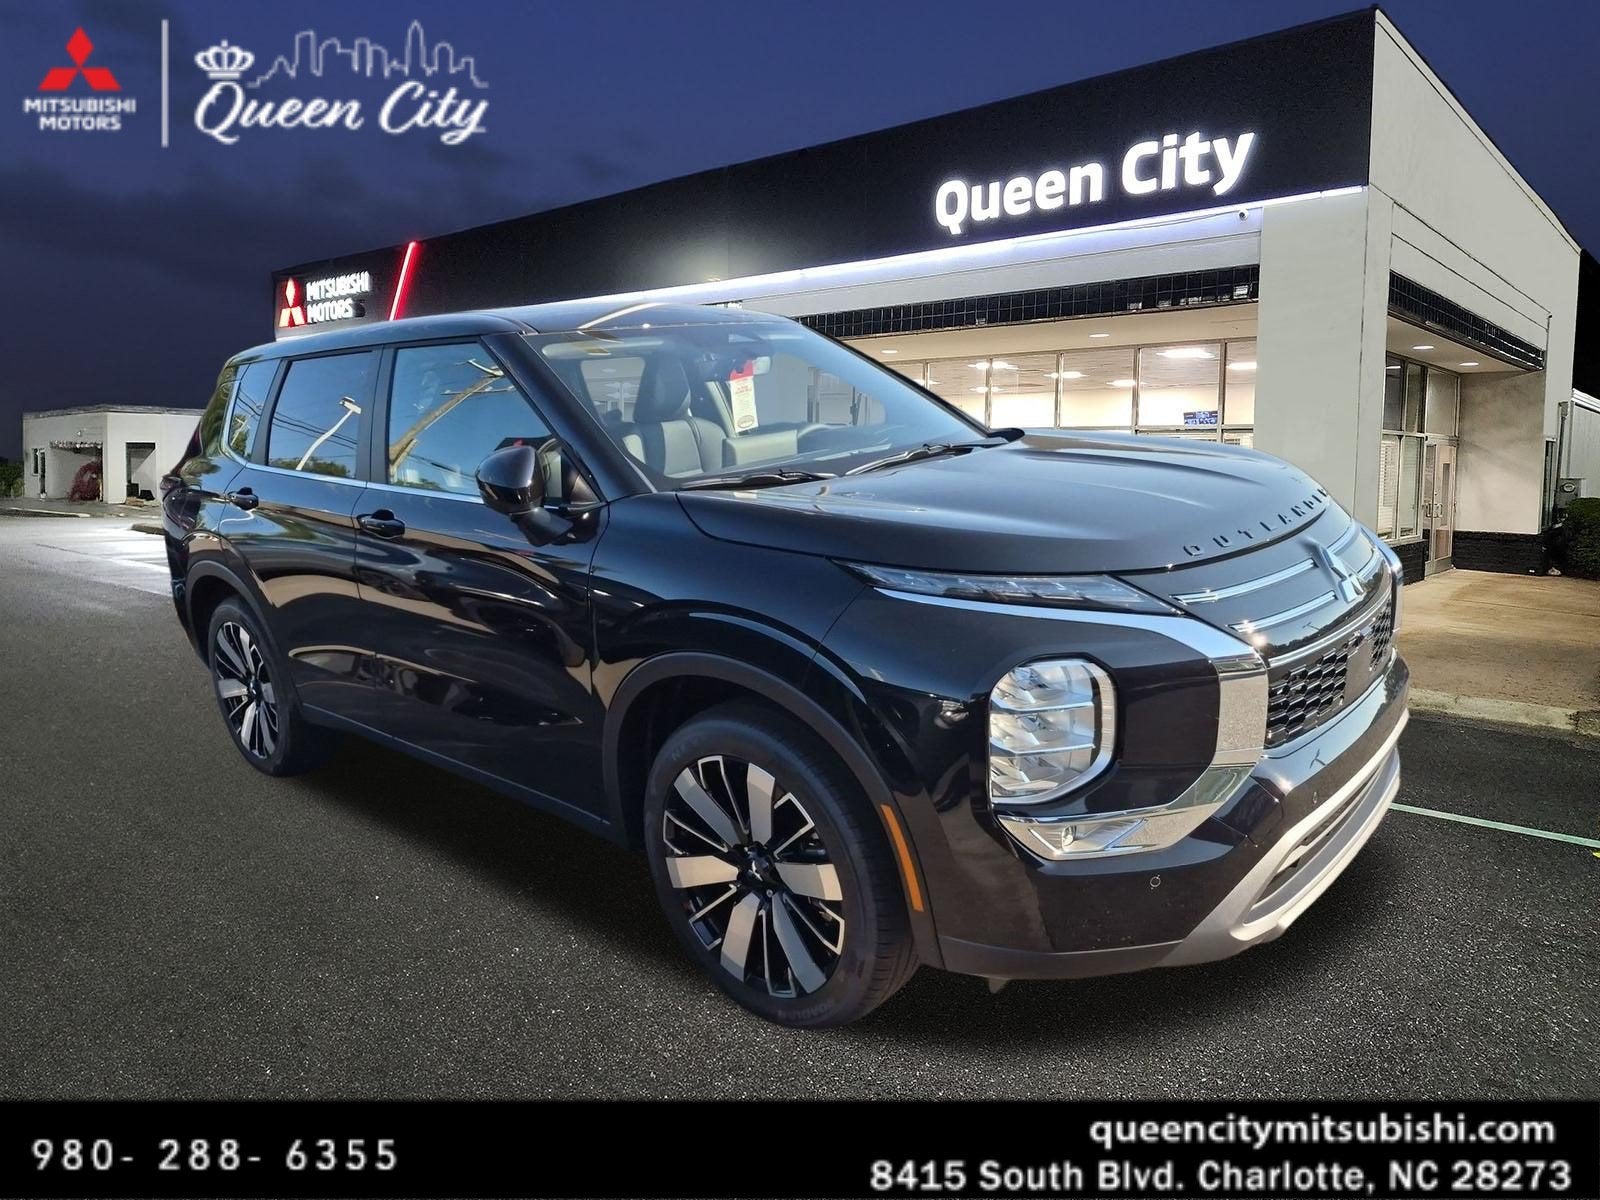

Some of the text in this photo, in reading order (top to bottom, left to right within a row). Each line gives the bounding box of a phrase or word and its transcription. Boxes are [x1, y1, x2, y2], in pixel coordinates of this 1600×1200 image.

[935, 131, 1255, 235] Queen City
[306, 271, 370, 301] MITSUBISHI
[306, 298, 353, 323] MOTORS
